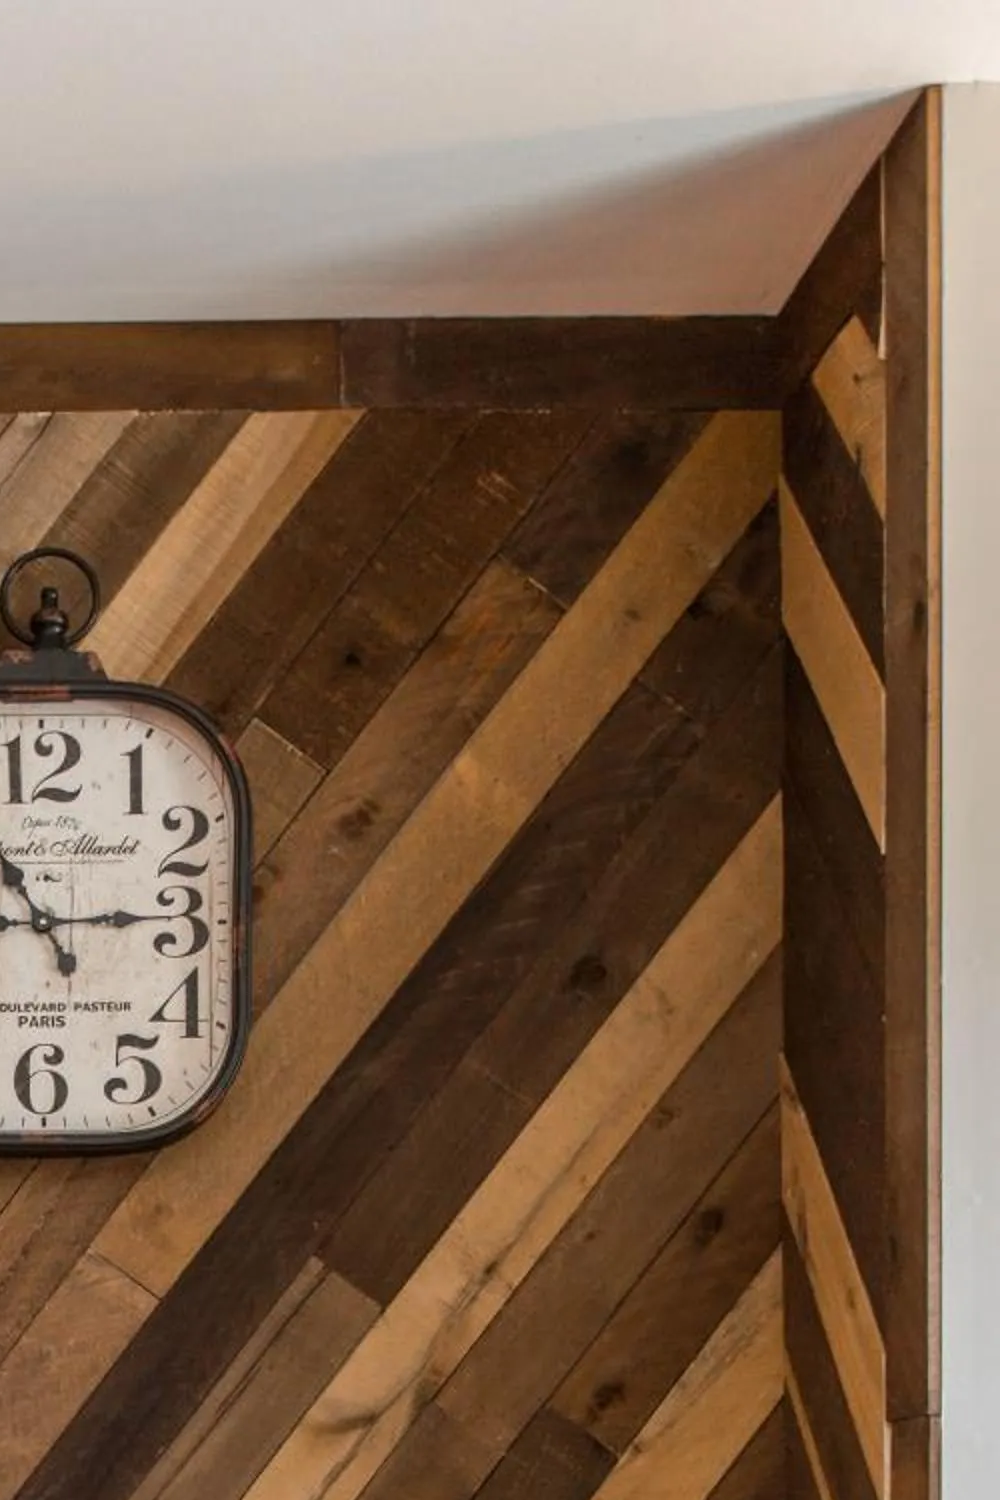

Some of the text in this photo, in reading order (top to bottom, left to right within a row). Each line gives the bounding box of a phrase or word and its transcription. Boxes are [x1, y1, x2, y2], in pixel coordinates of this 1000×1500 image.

[0, 730, 83, 805] 12
[121, 743, 145, 815] 1
[157, 805, 210, 878] 2
[152, 885, 210, 959] 3
[18, 1015, 66, 1028] PARIS
[73, 1002, 132, 1012] PASTEUR
[148, 966, 208, 1039] 4
[13, 1043, 69, 1115] 6
[103, 1033, 162, 1104] 5
